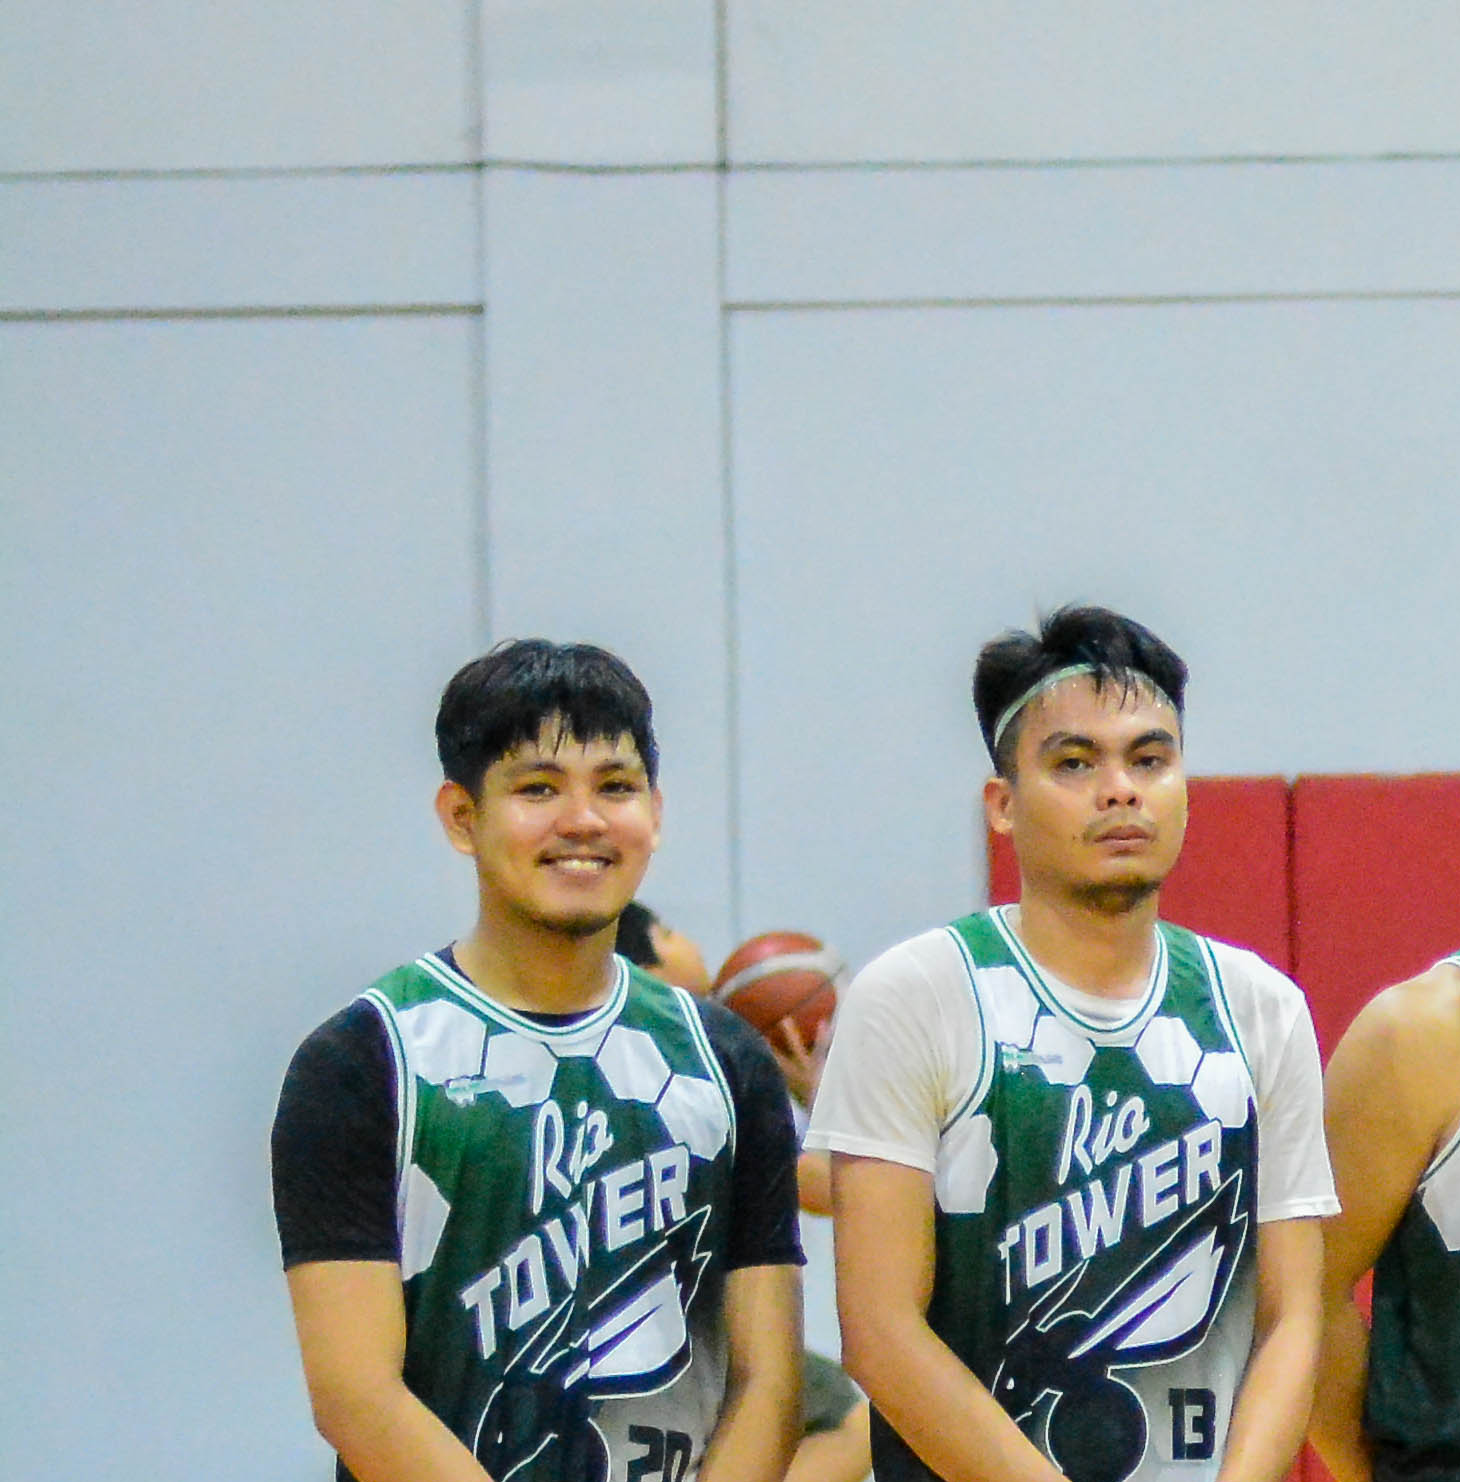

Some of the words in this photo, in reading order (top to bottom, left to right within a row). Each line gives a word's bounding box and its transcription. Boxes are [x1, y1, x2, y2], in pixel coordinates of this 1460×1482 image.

[532, 1099, 614, 1216] Rio
[1059, 1084, 1149, 1185] Rio
[1168, 1388, 1216, 1460] 13
